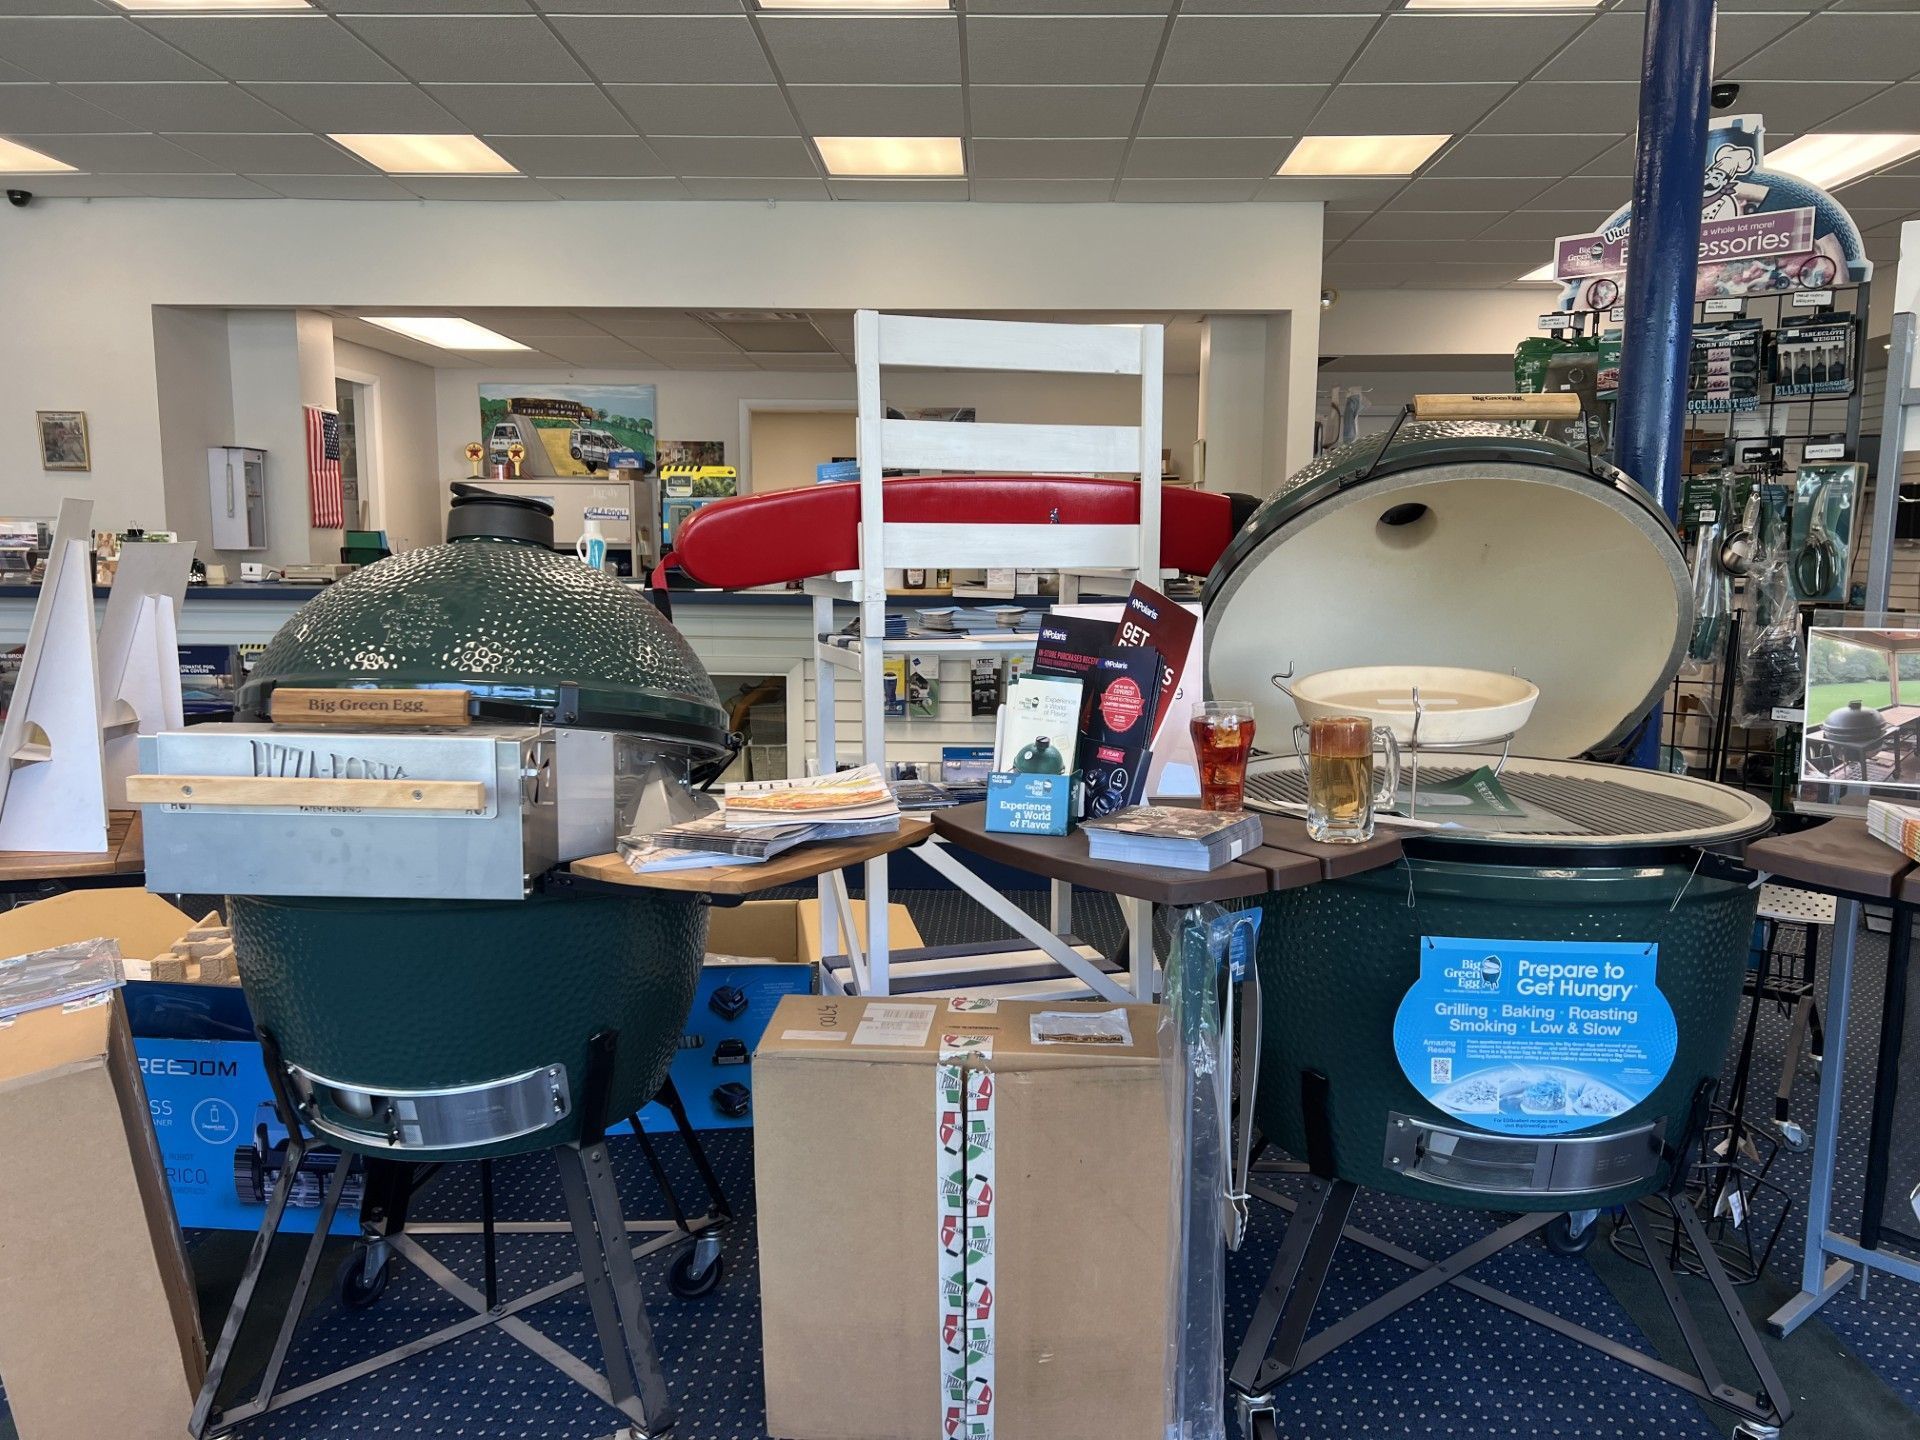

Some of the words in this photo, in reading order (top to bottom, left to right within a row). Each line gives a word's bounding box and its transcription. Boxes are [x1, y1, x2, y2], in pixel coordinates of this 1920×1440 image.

[1710, 226, 1735, 236] whole
[1737, 223, 1748, 231] lot
[1750, 220, 1775, 231] more!
[1800, 329, 1845, 338] TABLECLOTH
[1696, 341, 1717, 349] CORN
[1718, 339, 1755, 348] HOLDERS
[1687, 398, 1740, 411] GCELLENT
[1136, 600, 1158, 620] Polaris
[1049, 629, 1067, 641] Polaris
[1122, 621, 1151, 647] GET
[1110, 660, 1128, 670] Polaris
[308, 699, 336, 713] Big
[340, 699, 390, 712] Green
[1044, 695, 1077, 705] Experience
[299, 805, 327, 813] PATENT
[327, 806, 363, 814] PENDING
[1000, 800, 1052, 813] Experience
[1014, 811, 1021, 819] a
[1023, 810, 1052, 821] World
[1009, 819, 1020, 828] of
[1021, 821, 1051, 831] Flavor
[1462, 959, 1482, 972] Big
[1518, 959, 1598, 982] Prepare
[1604, 961, 1625, 979] to
[1444, 968, 1481, 979] Green
[1458, 978, 1482, 990] Egg
[1517, 978, 1556, 996] Get
[1560, 980, 1632, 1002] Hungry
[1435, 1002, 1488, 1018] Grilling
[1502, 1004, 1556, 1020] Baking
[1568, 1006, 1638, 1024] Roasting
[1450, 1018, 1517, 1035] Smoking
[1531, 1021, 1563, 1035] Low
[1567, 1021, 1579, 1035] &
[1583, 1022, 1622, 1036] Slow
[1423, 1039, 1456, 1048] Amazing
[1427, 1046, 1456, 1054] Results
[138, 1057, 238, 1078] REEDOM
